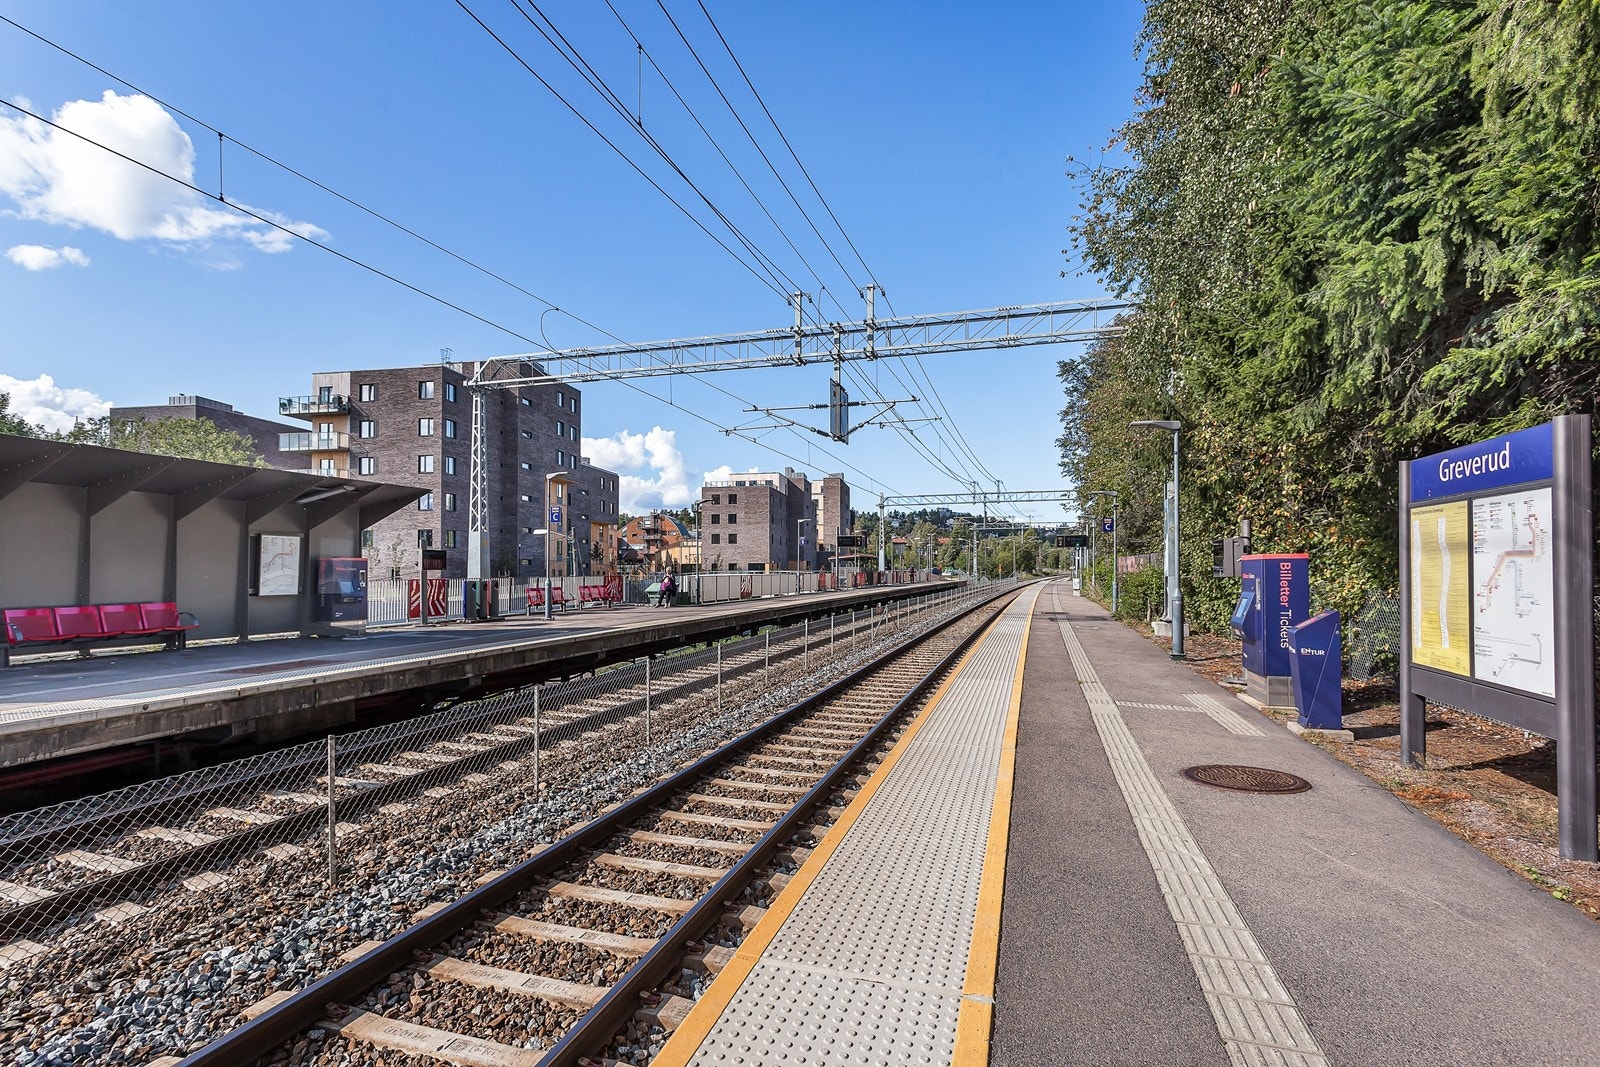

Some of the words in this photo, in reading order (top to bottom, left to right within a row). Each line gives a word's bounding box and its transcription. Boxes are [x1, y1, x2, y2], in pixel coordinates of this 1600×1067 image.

[1439, 441, 1510, 482] Greverud
[552, 513, 559, 521] C
[1280, 562, 1292, 607] Billetter
[1280, 609, 1292, 649] Tickets
[1300, 648, 1325, 656] ENTUR
